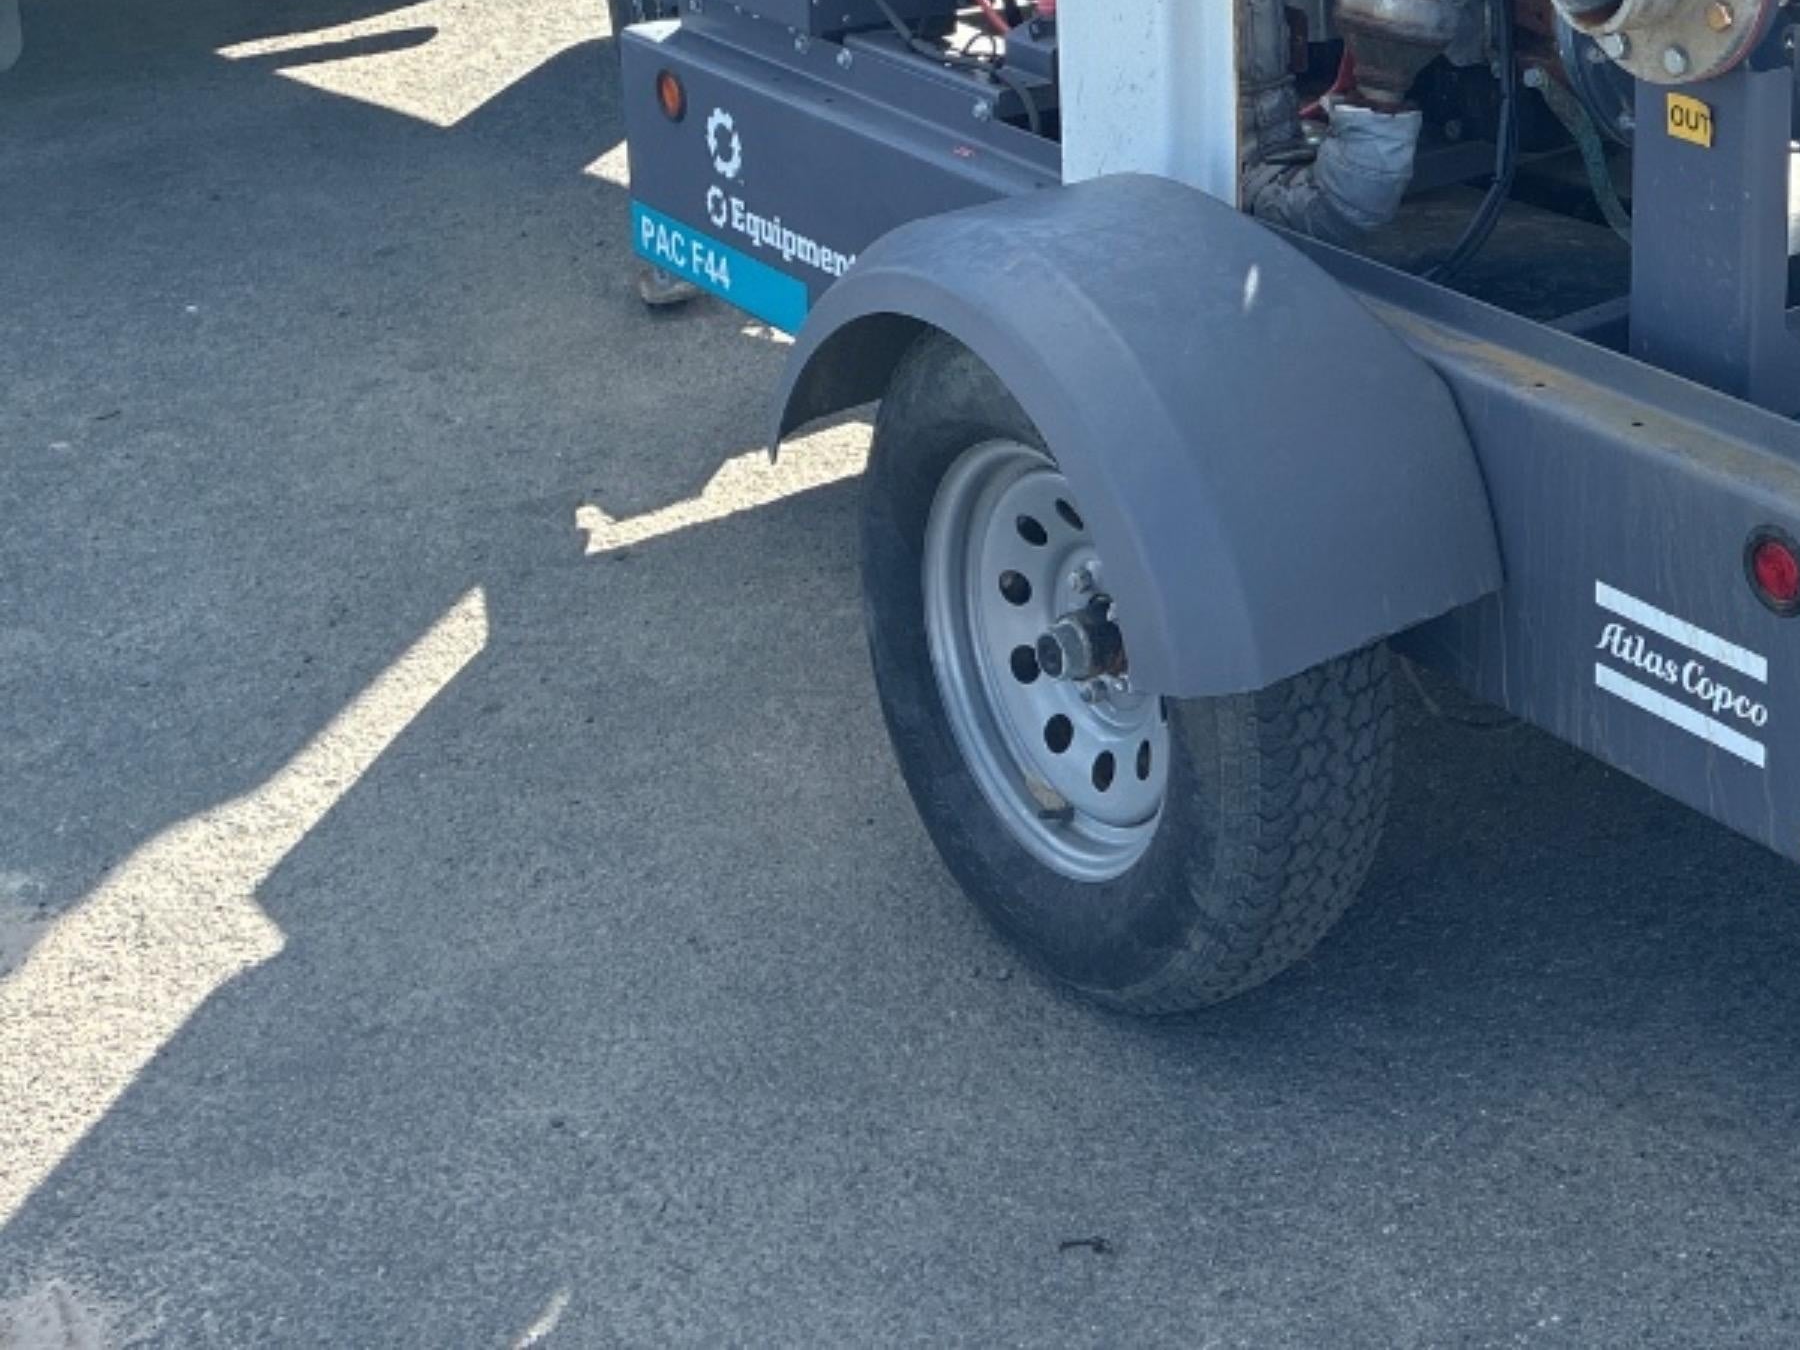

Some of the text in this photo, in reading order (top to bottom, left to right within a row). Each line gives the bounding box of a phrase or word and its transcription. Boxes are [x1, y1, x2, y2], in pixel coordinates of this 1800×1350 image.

[1671, 104, 1708, 135] OUT
[641, 214, 731, 291] PAC F44
[729, 196, 856, 278] Equipmen
[1595, 622, 1768, 727] Atlas Copco
